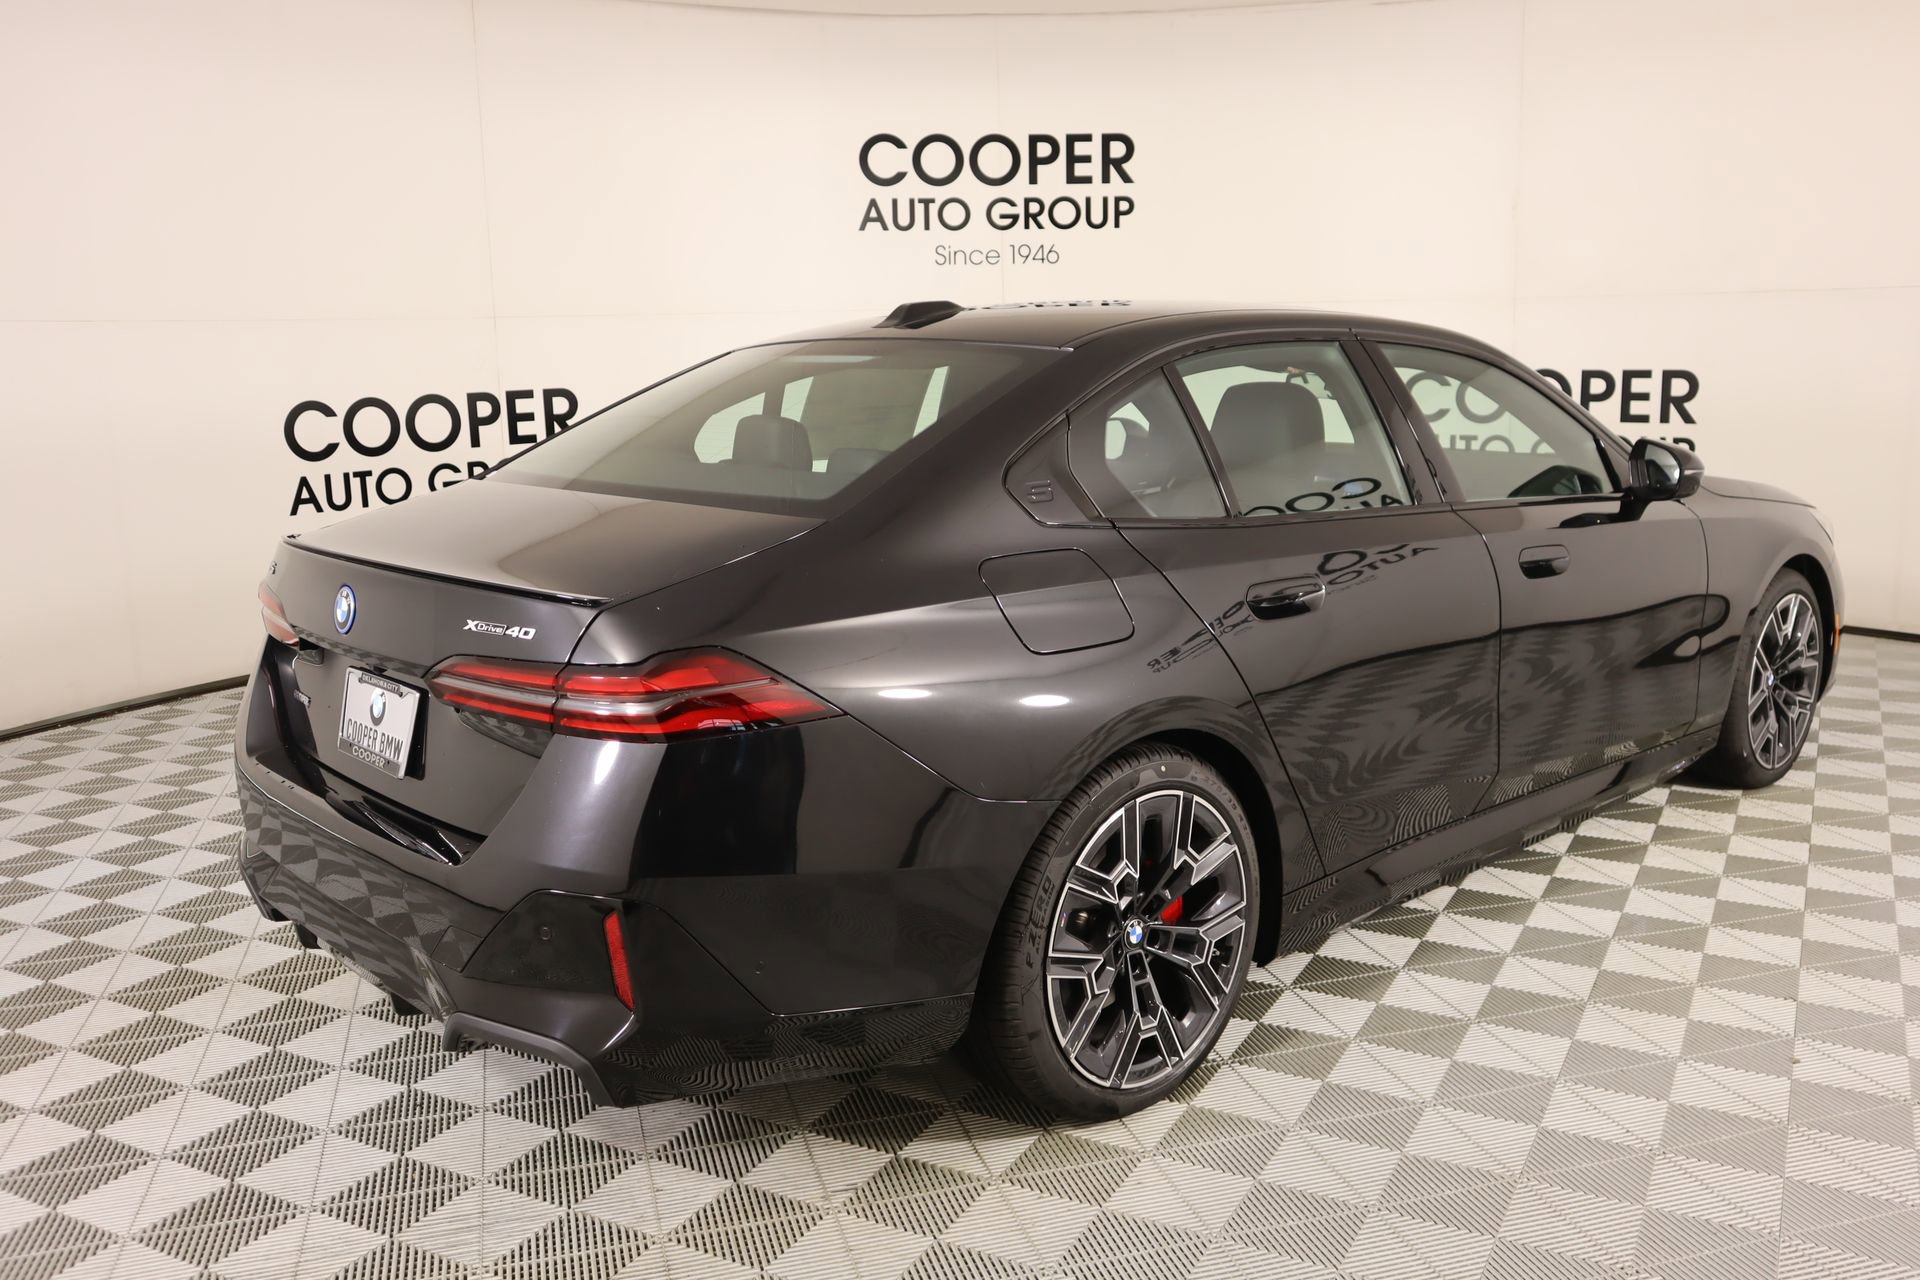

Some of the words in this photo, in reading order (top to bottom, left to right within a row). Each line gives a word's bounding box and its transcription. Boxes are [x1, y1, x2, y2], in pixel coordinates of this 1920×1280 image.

[858, 133, 1136, 187] COOPER
[858, 197, 971, 231] AUTO
[985, 196, 1135, 231] GROUP
[934, 244, 1001, 266] Since
[1009, 243, 1060, 265] 1946
[1406, 368, 1700, 424] COPER
[283, 387, 579, 462] COOPER
[289, 467, 412, 516] AUTO
[346, 718, 379, 751] COOPER
[379, 732, 404, 760] BMW
[352, 745, 386, 769] COOPER
